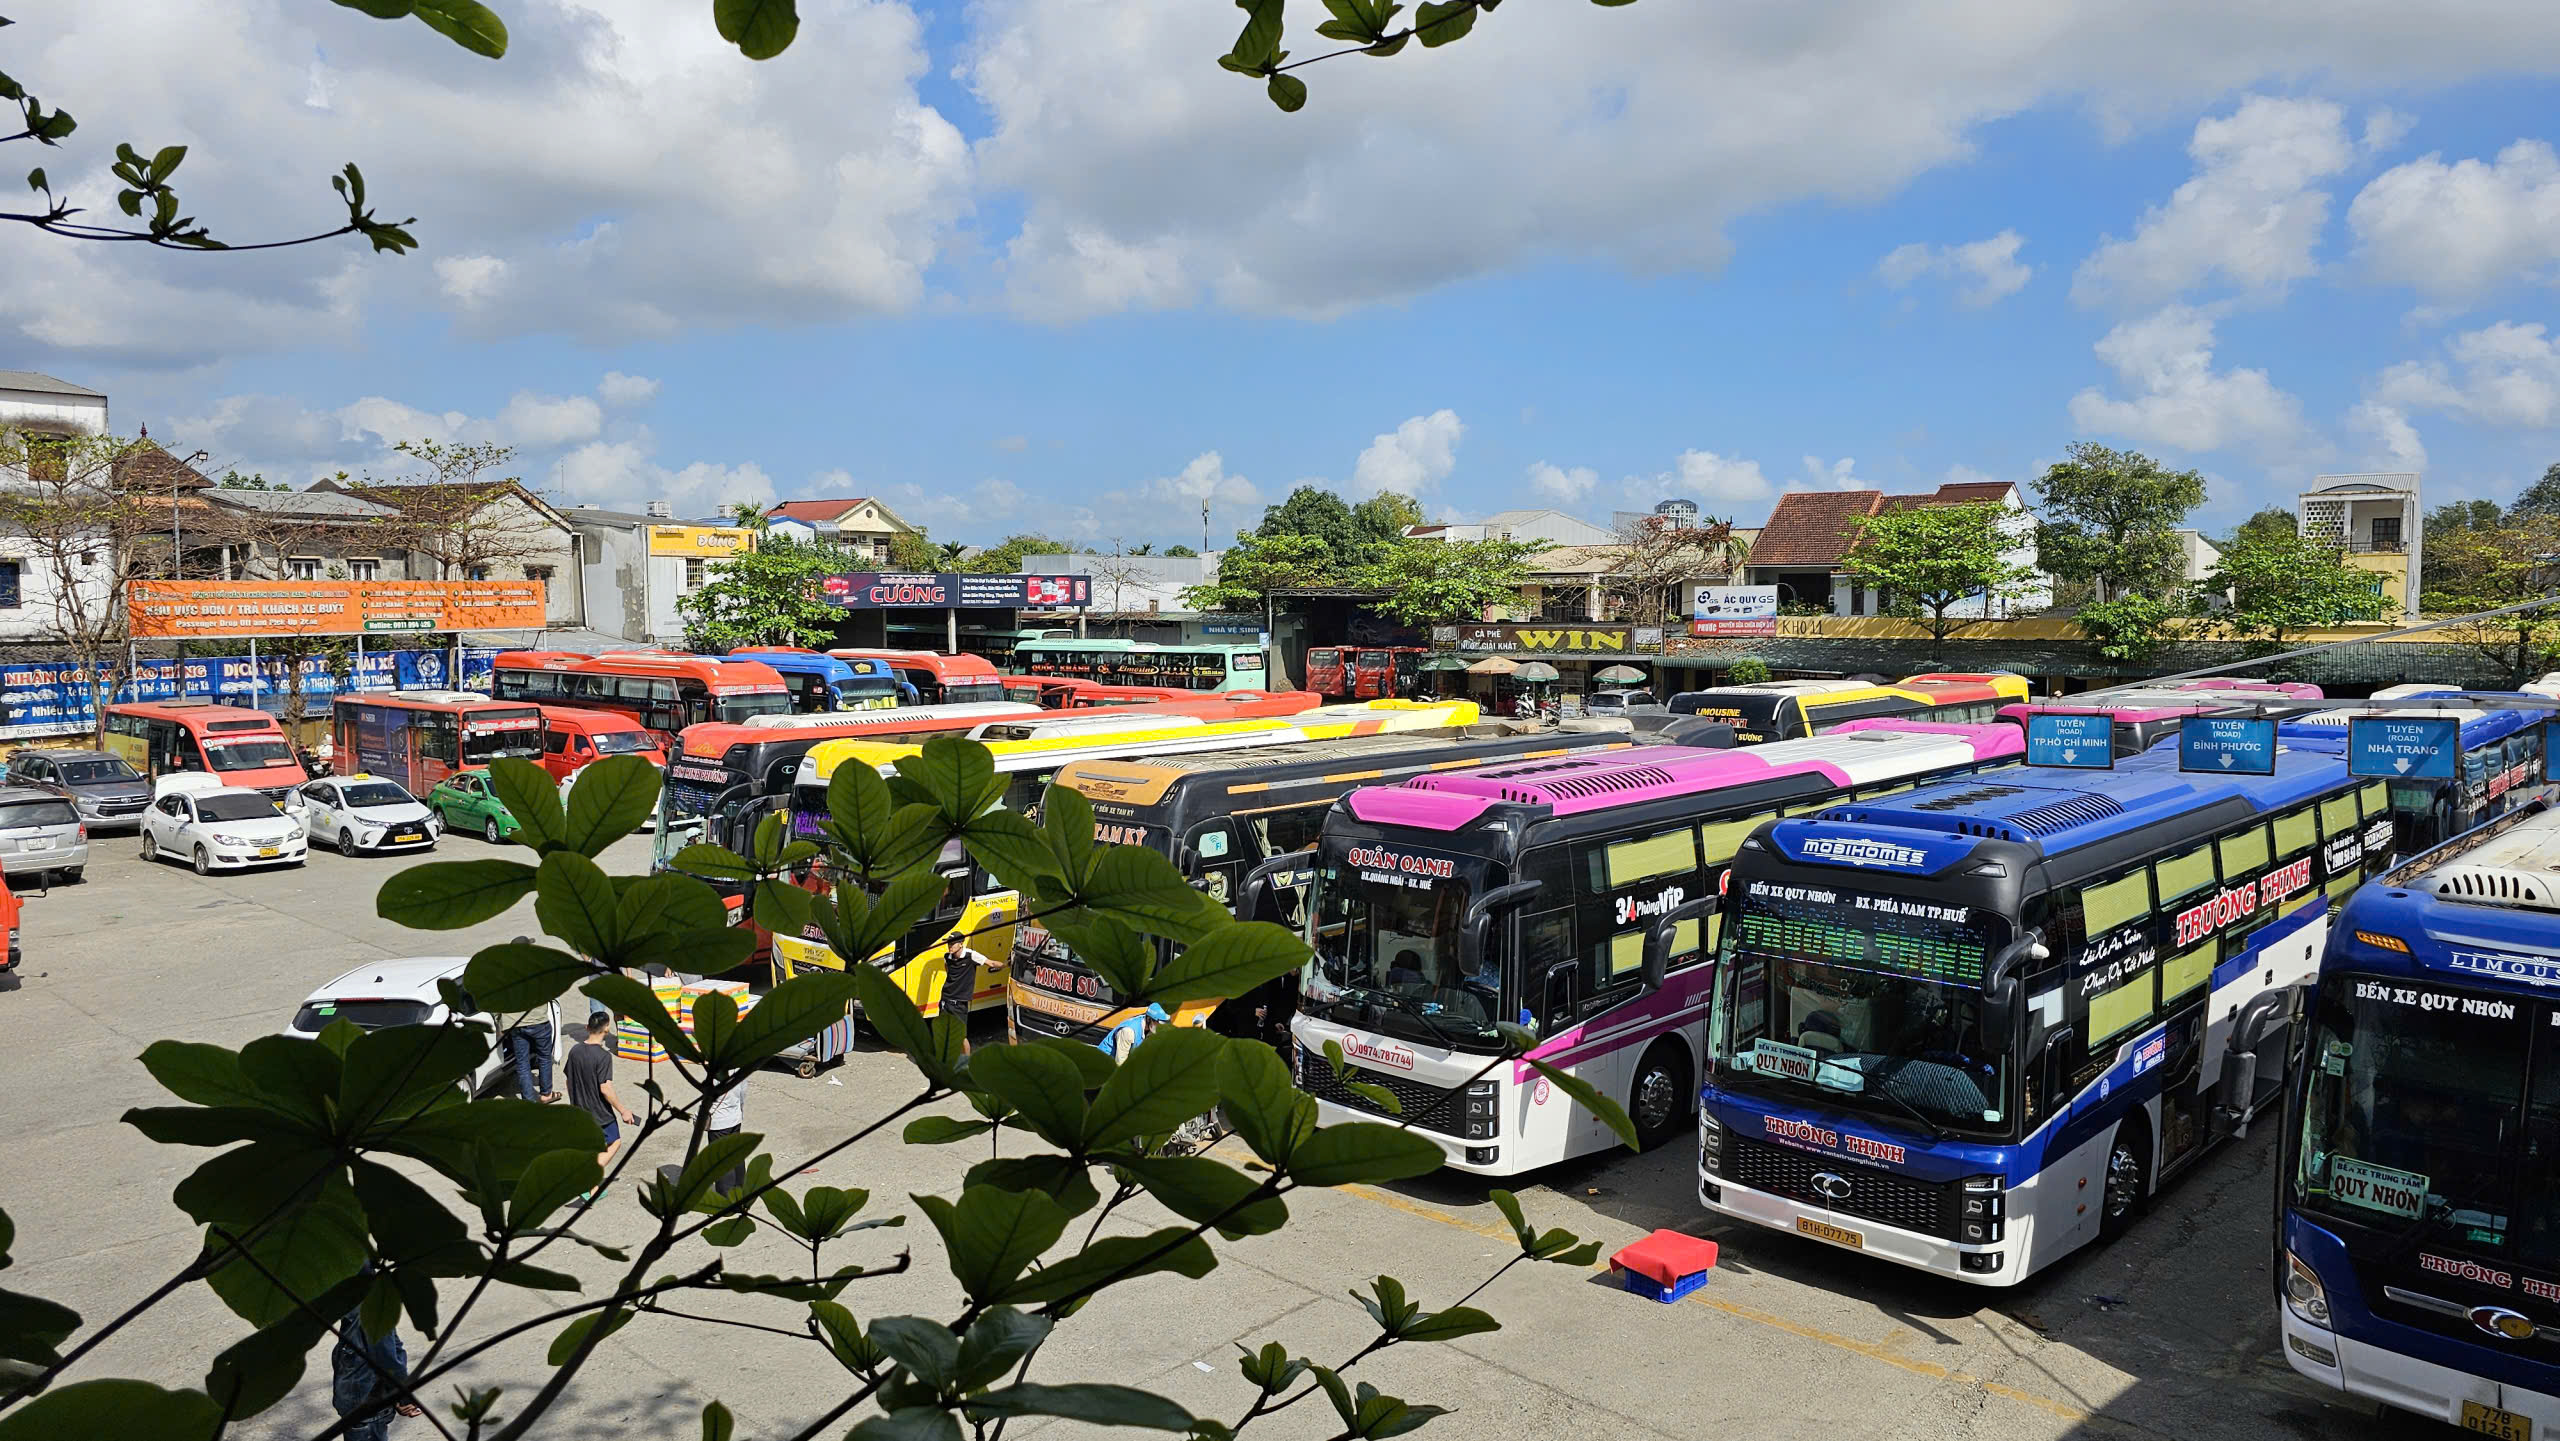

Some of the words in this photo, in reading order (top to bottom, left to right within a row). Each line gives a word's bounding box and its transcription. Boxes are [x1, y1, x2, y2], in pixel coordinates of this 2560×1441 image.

[870, 584, 945, 603] CƯỜNG
[1739, 595, 1757, 604] QUY
[1758, 595, 1774, 604] GS
[302, 604, 316, 614] XE
[1783, 621, 1807, 634] KHO
[1475, 628, 1485, 638] CÀ
[1486, 628, 1502, 638] PHÊ
[1515, 630, 1627, 650] WIN
[4, 669, 57, 687] NHẬN
[1696, 708, 1742, 717] LIMOUSINE
[2057, 728, 2083, 736] (ROAD)
[2082, 738, 2107, 747] MINH
[2388, 735, 2420, 743] (ROAD)
[2368, 744, 2394, 753] NHA
[2396, 745, 2439, 755] TRANG
[1093, 822, 1123, 844] TAM
[1348, 845, 1398, 870] QUÂN
[1400, 855, 1454, 878] OANH
[1804, 840, 1925, 864] MOBIHOMES
[1615, 895, 1636, 924] 34
[1750, 880, 1771, 896] BẾN
[1770, 885, 1784, 897] XE
[1784, 886, 1806, 901] QUY
[1807, 890, 1837, 905] NHƠN
[1901, 902, 1926, 917] NAM
[2176, 880, 2257, 948] TRƯỜNG
[2260, 855, 2312, 907] THỊNH
[1034, 965, 1074, 992] MINH
[2356, 980, 2391, 1000] BẾN
[2393, 989, 2417, 1005] XE
[2420, 992, 2459, 1012] QUY
[2461, 1000, 2516, 1020] NHƠN
[1358, 1044, 1412, 1067] 0974.787744
[1756, 1052, 1778, 1070] QUY
[1780, 1057, 1810, 1078] NHƠN
[1765, 1115, 1838, 1148] TRƯỜNG
[1845, 1134, 1905, 1164] THỊNH
[1779, 1137, 1806, 1149] Website:
[2356, 1167, 2368, 1176] XE
[2370, 1170, 2399, 1184] TRUNG
[2334, 1174, 2369, 1199] QUY
[2371, 1183, 2420, 1213] NHƠN
[1802, 1220, 1857, 1244] 81H-077.75
[2419, 1252, 2513, 1289] TRƯỜNG
[2482, 1406, 2511, 1425] 77B
